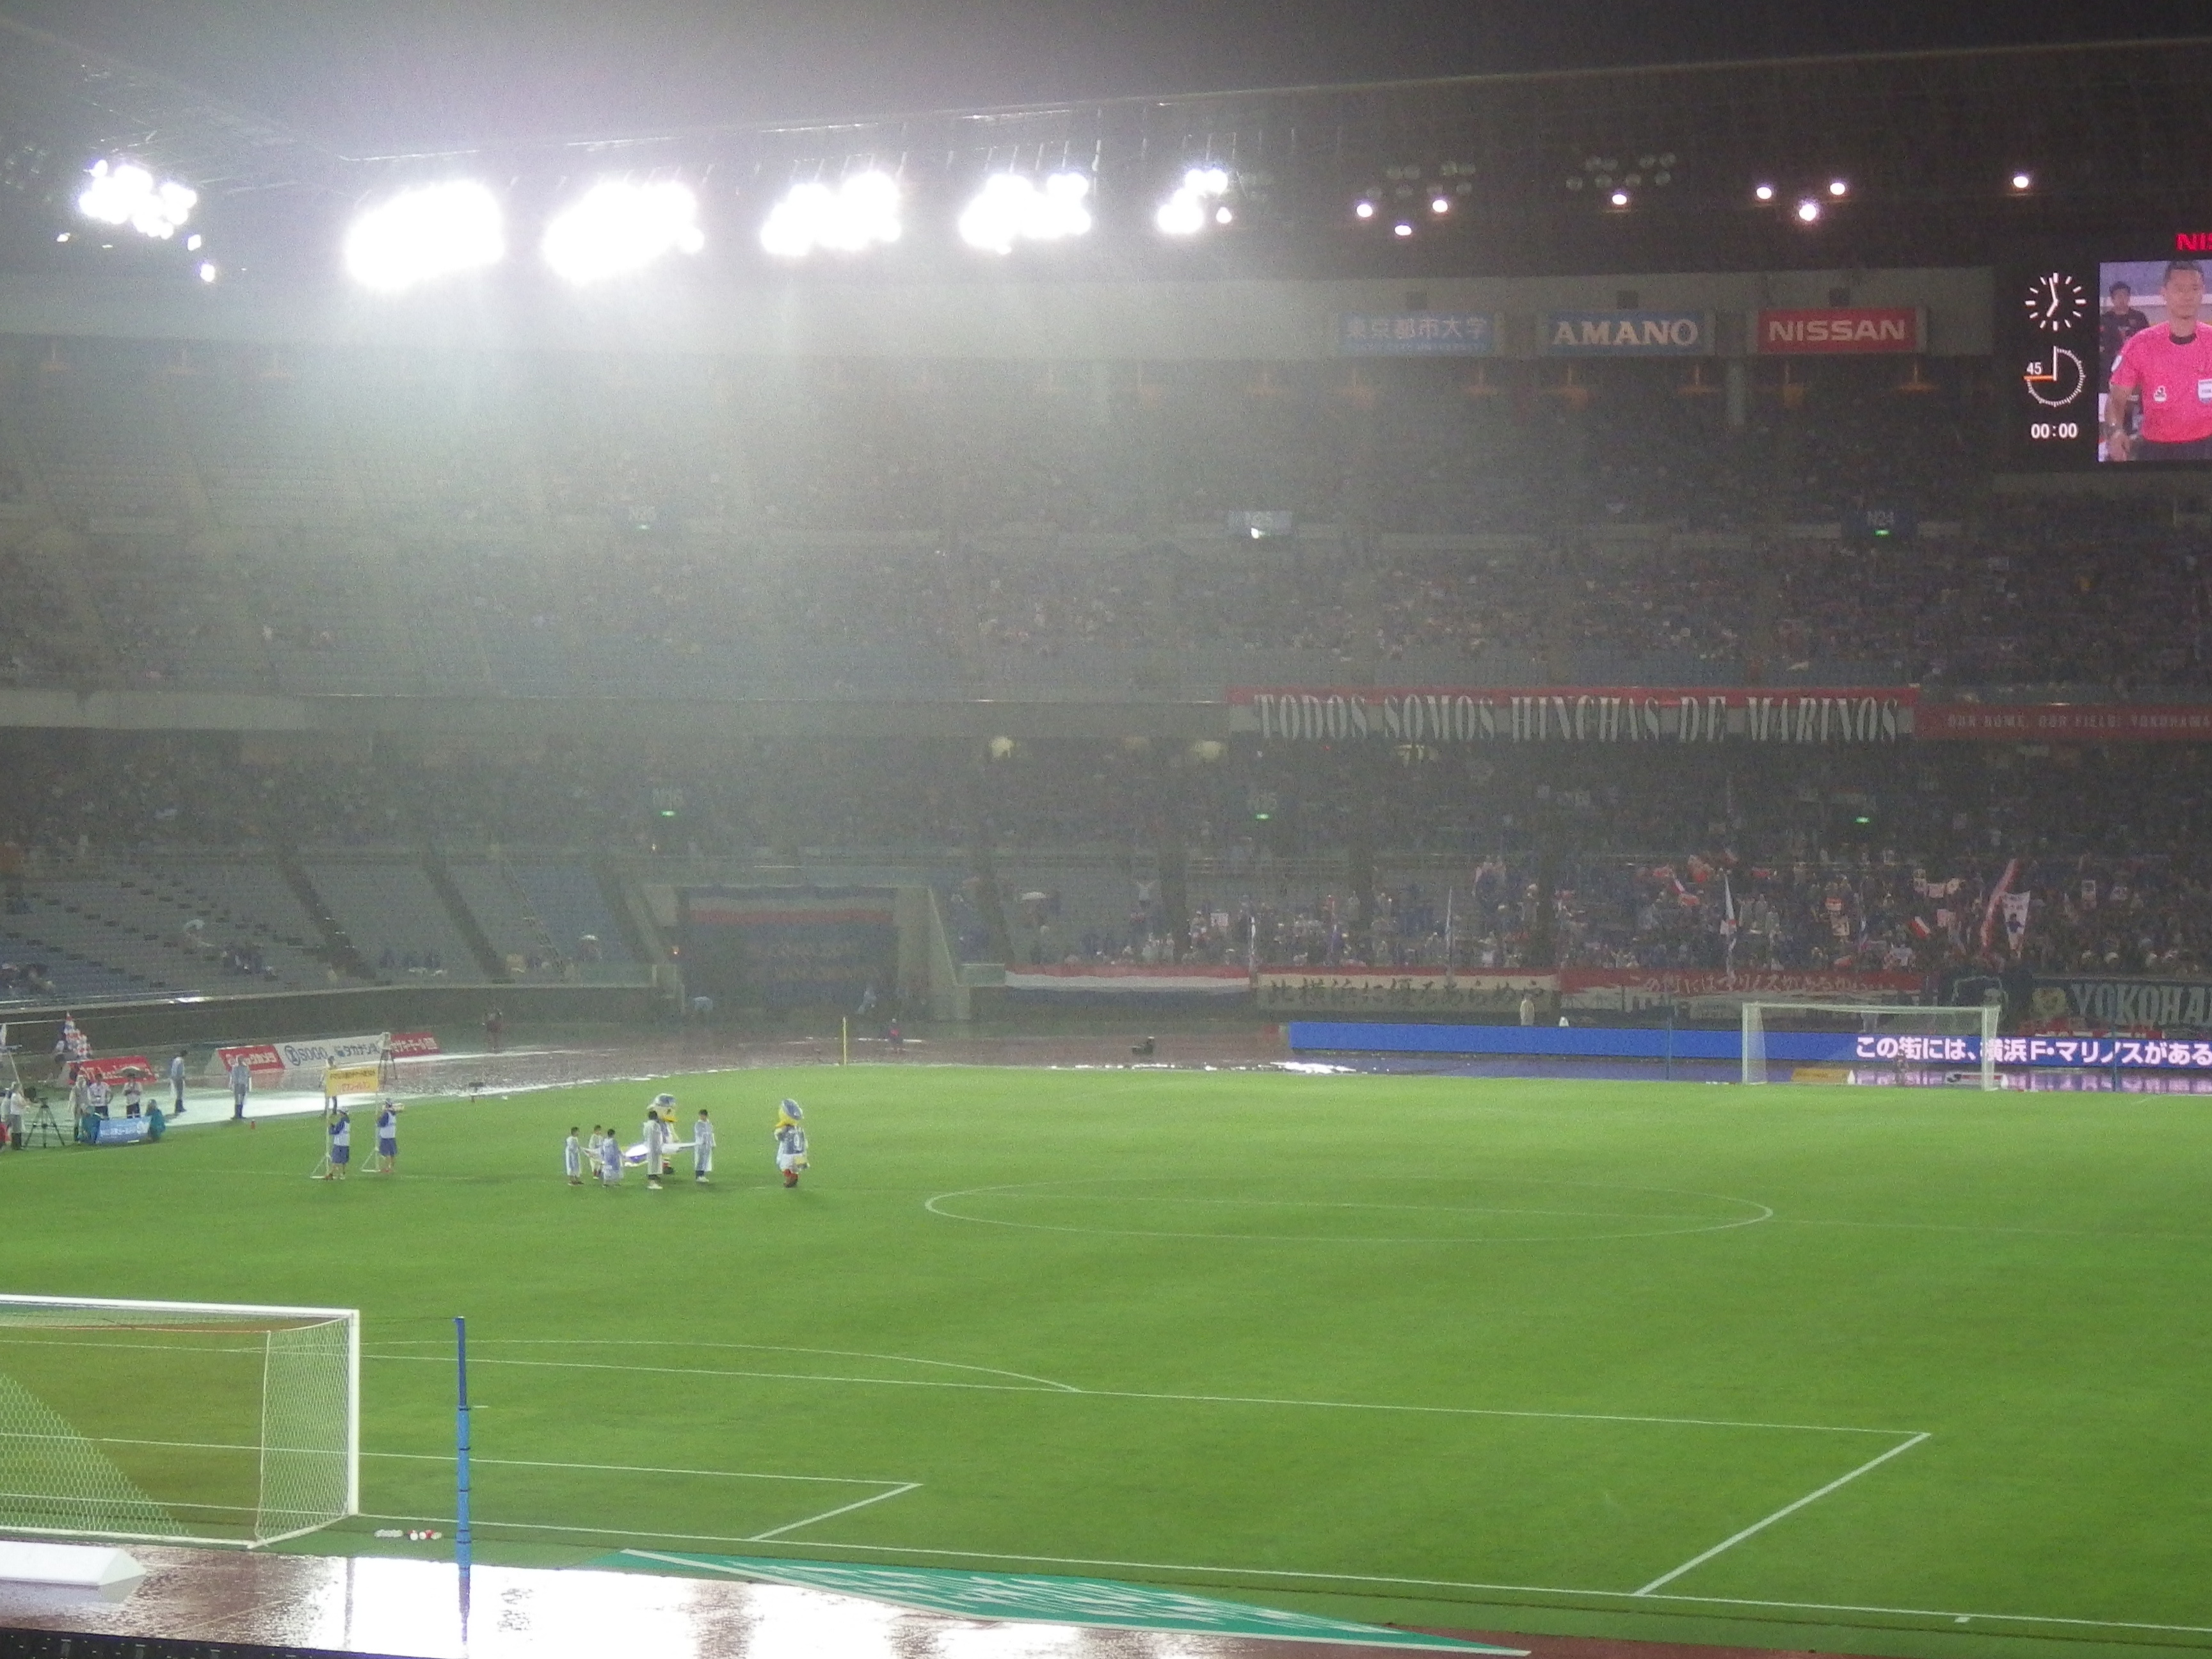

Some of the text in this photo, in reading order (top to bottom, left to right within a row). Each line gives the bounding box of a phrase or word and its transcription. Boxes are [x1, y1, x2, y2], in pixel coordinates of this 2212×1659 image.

[2177, 233, 2212, 251] NI
[1552, 319, 1699, 346] AMANO
[1768, 318, 1905, 342] NISSAN
[2026, 362, 2042, 375] 45
[2031, 422, 2078, 439] 00:00
[2070, 982, 2212, 1026] YOKOHA
